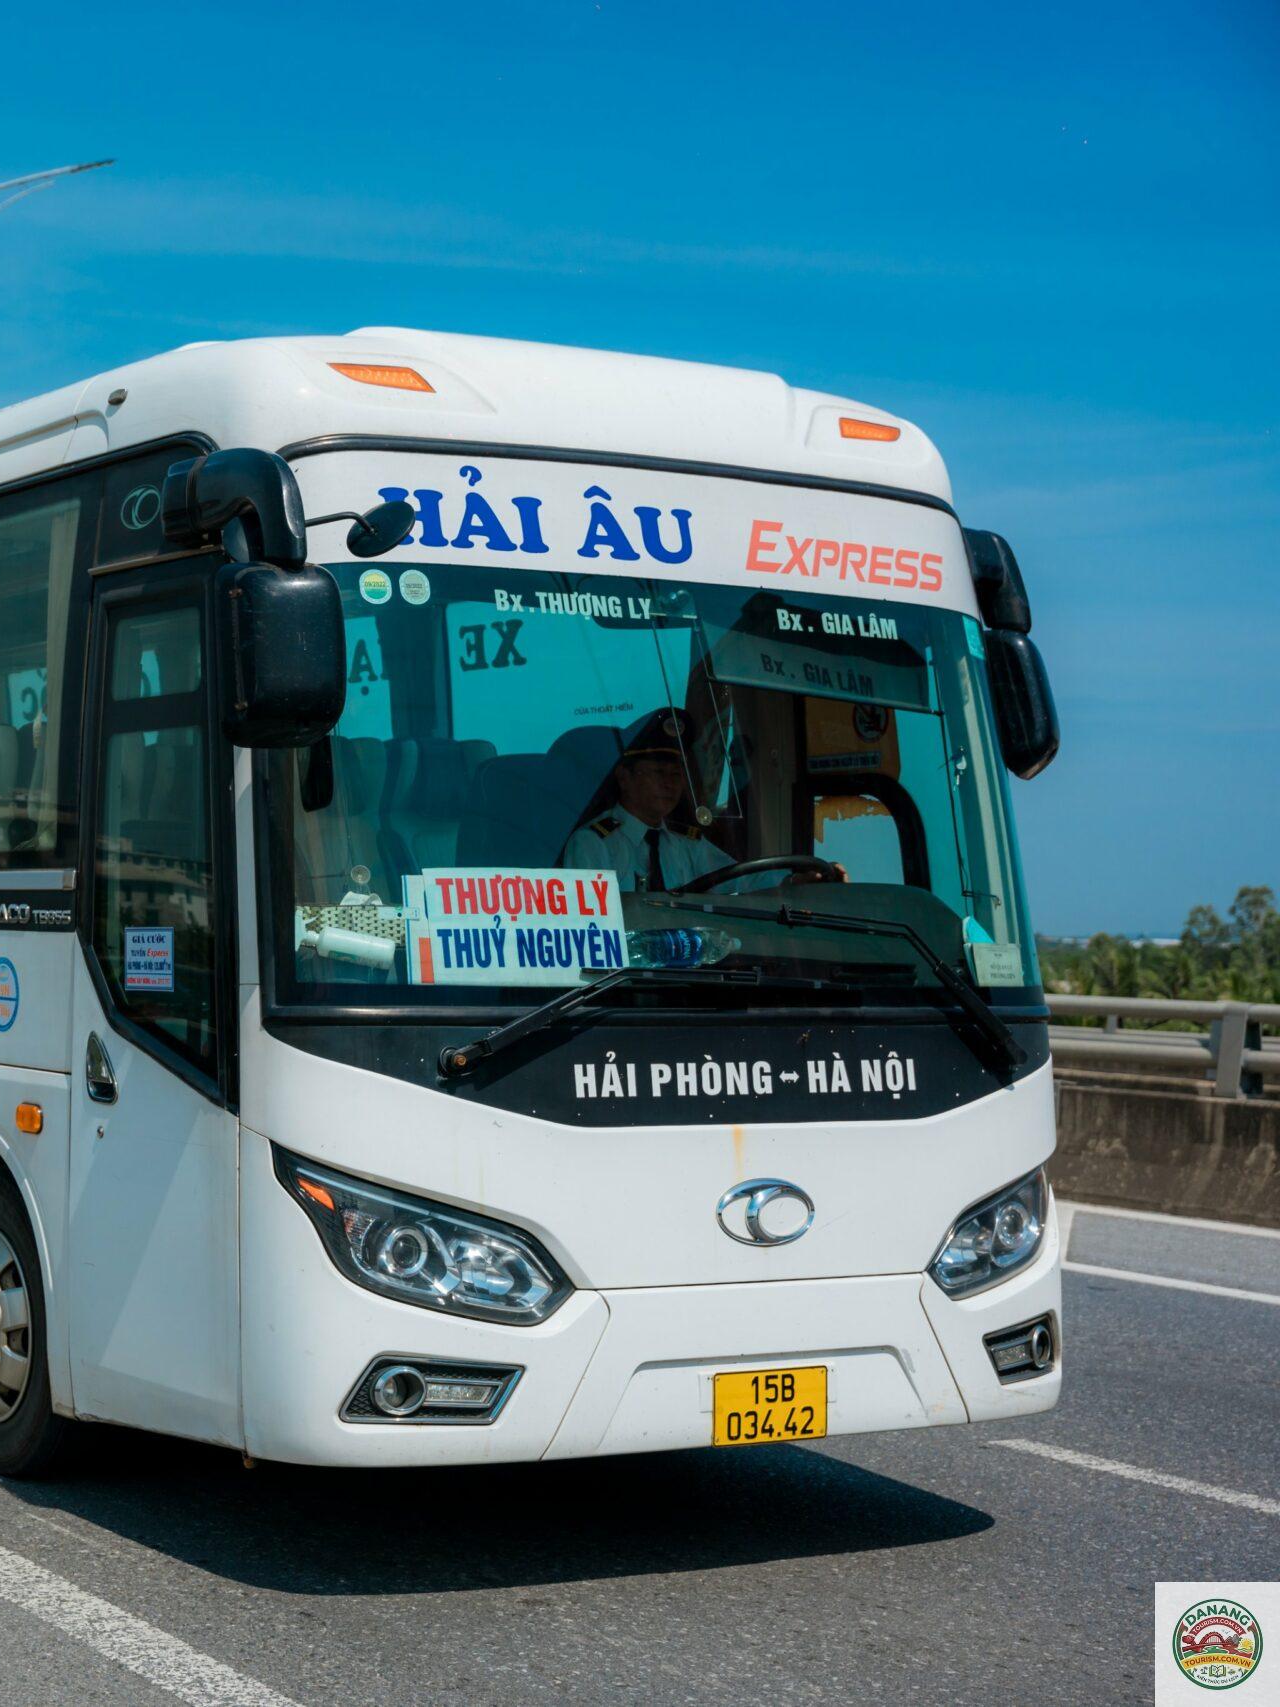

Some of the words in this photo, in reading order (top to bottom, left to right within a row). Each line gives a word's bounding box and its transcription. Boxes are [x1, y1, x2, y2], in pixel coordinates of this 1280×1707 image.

[378, 465, 549, 553] HẢI
[577, 485, 692, 564] ÂU
[821, 612, 855, 636] GIA
[858, 613, 898, 640] LÂM
[803, 662, 833, 688] GIA
[435, 874, 568, 921] THƯỢNG
[575, 873, 608, 916] LÝ
[517, 922, 624, 968] NGUYÊN
[574, 1051, 637, 1098] HẢI
[651, 1054, 773, 1097] PHÒNG
[807, 1052, 851, 1093] HÀ
[861, 1051, 916, 1099] NỘI
[752, 1374, 795, 1404] 15B
[727, 1406, 814, 1440] 034.42
